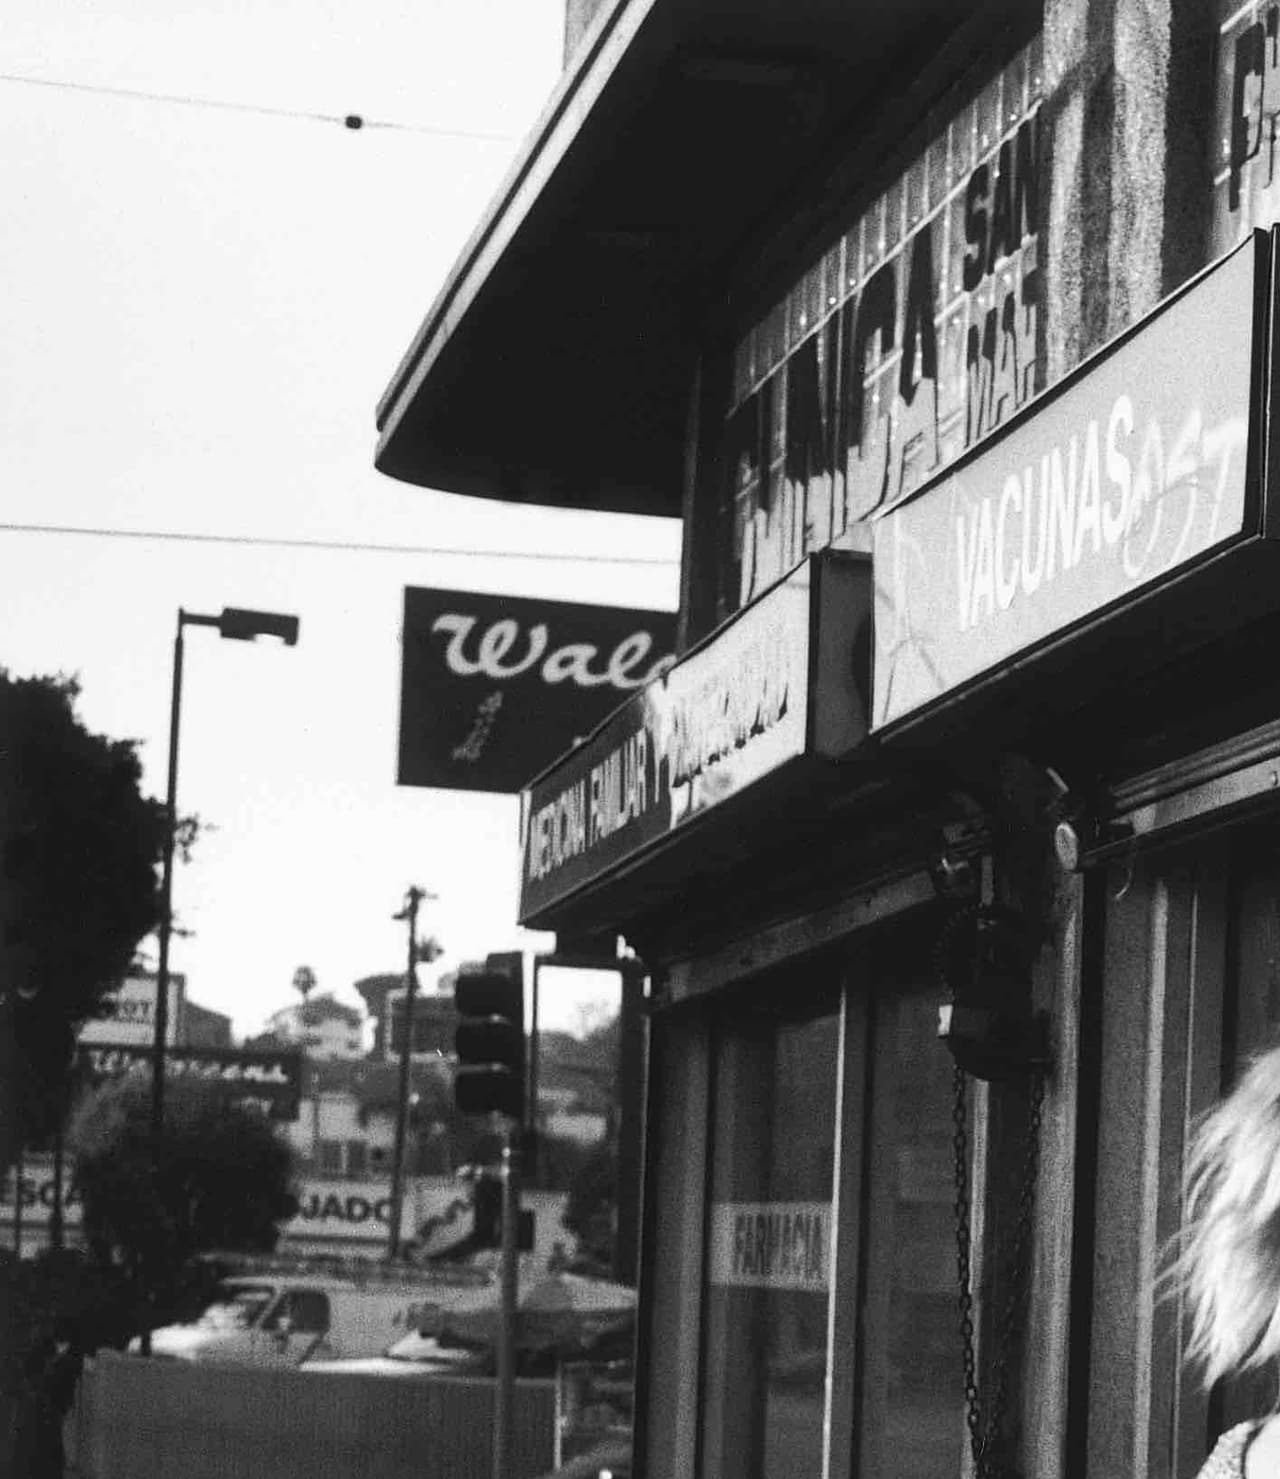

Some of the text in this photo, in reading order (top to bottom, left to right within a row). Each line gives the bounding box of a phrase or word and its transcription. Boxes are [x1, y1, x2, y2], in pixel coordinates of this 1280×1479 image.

[963, 108, 1040, 292] SAN
[956, 395, 1134, 632] VACUNAS
[432, 613, 679, 689] Wal
